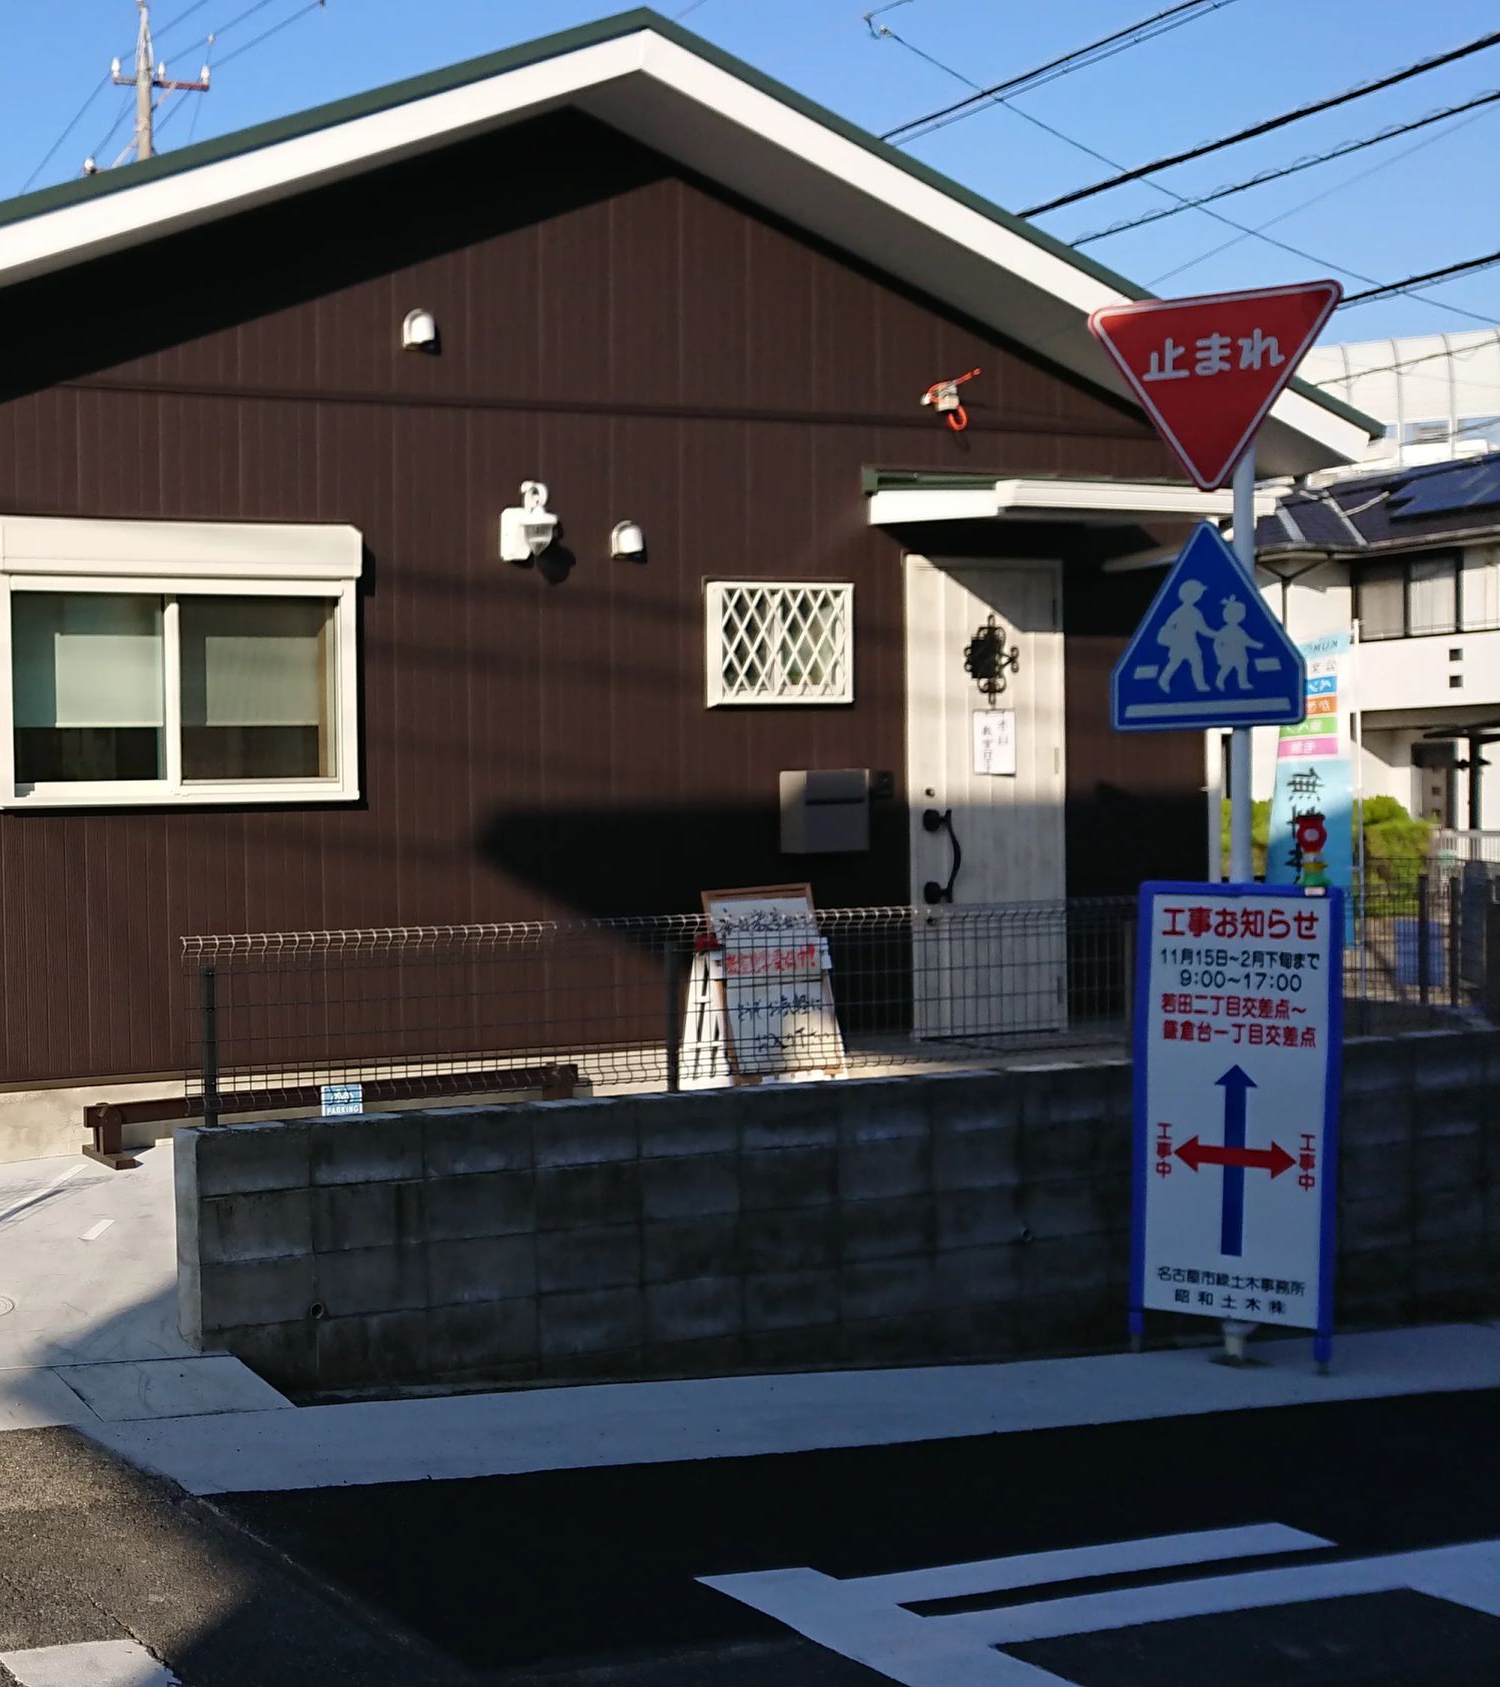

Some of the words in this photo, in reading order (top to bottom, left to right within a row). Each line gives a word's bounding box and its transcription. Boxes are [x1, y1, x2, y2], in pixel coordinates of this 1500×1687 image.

[1142, 328, 1285, 382] 止まれ
[1162, 906, 1319, 940] 工事お知らせ
[1180, 969, 1302, 992] 9:00～17:00
[326, 1105, 359, 1116] PARKING
[1156, 1122, 1172, 1179] 工事中
[1298, 1133, 1316, 1192] 工事中
